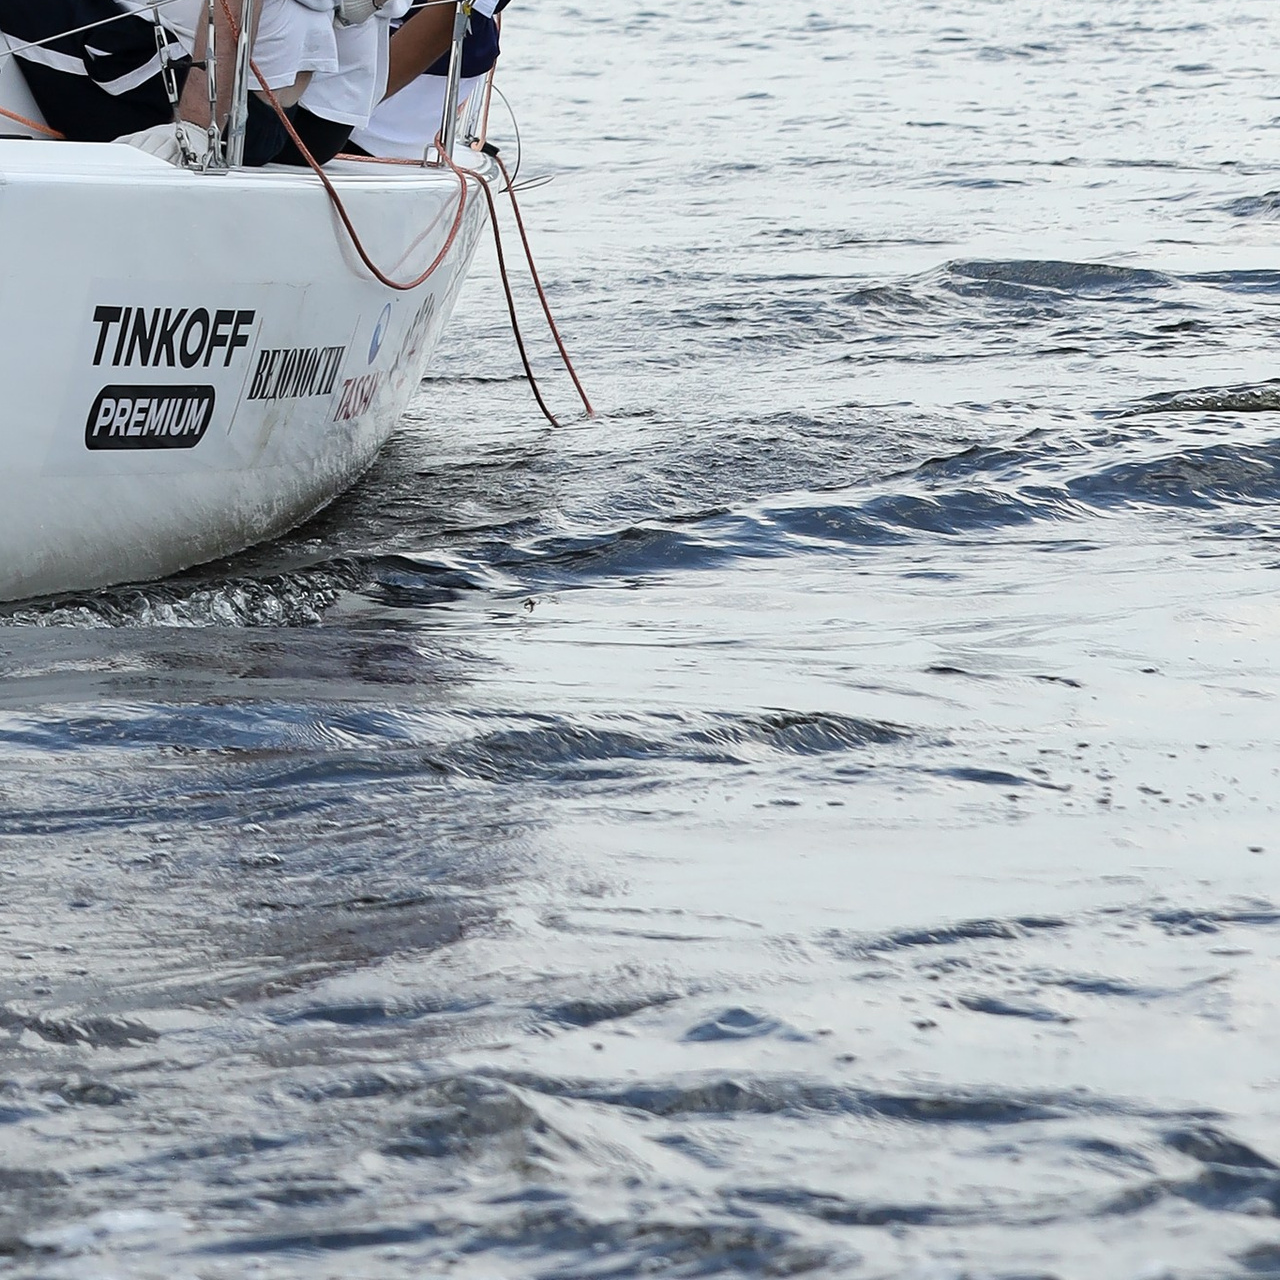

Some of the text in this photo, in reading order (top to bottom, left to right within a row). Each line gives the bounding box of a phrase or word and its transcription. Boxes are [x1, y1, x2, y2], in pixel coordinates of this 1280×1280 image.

[92, 305, 256, 369] TINKOFF
[246, 345, 346, 407] ВЕДОМОСТИ
[92, 398, 209, 437] PREMIUM
